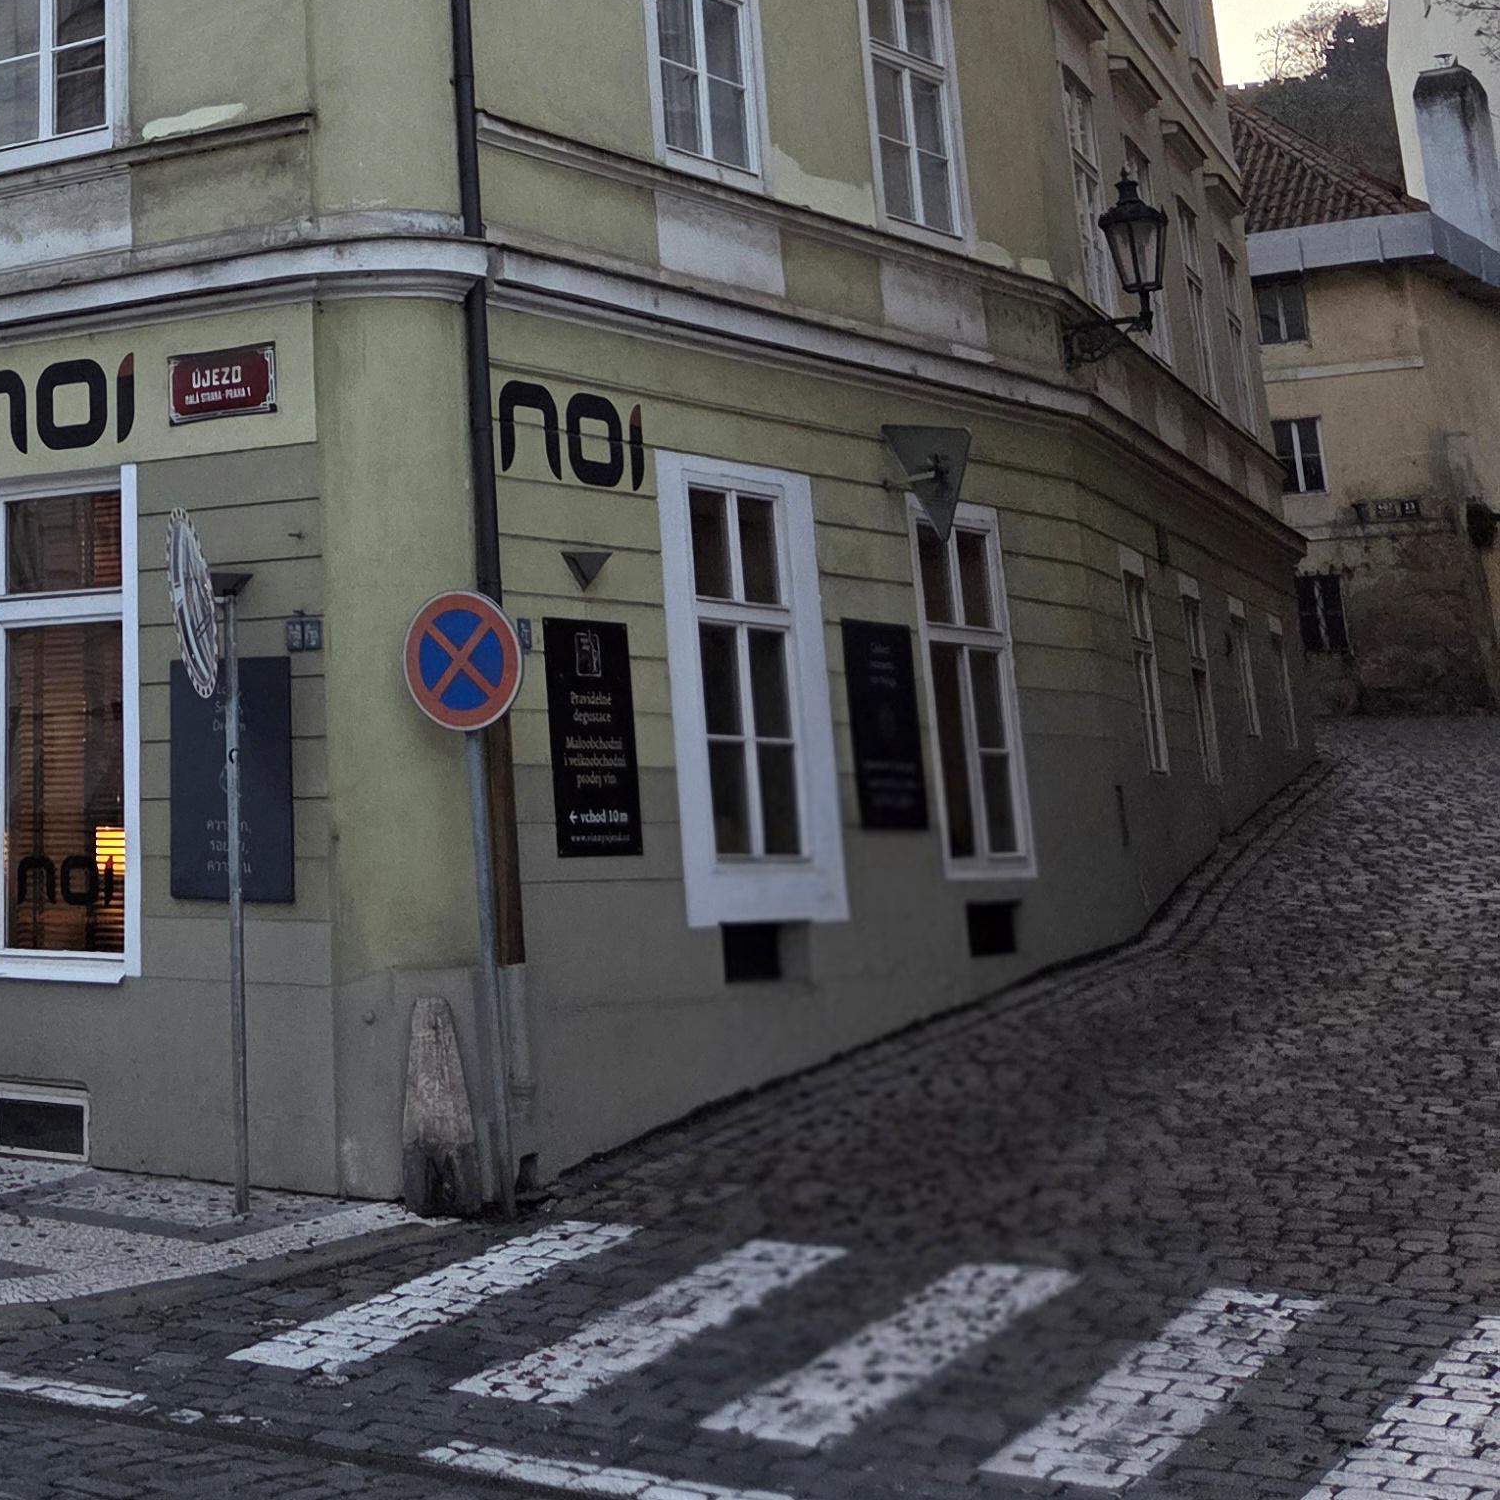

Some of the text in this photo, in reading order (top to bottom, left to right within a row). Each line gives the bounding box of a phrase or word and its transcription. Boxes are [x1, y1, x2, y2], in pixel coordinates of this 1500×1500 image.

[192, 365, 242, 389] ÚJEZD
[499, 379, 645, 492] noi
[580, 808, 606, 823] vchod
[17, 855, 114, 906] noi
